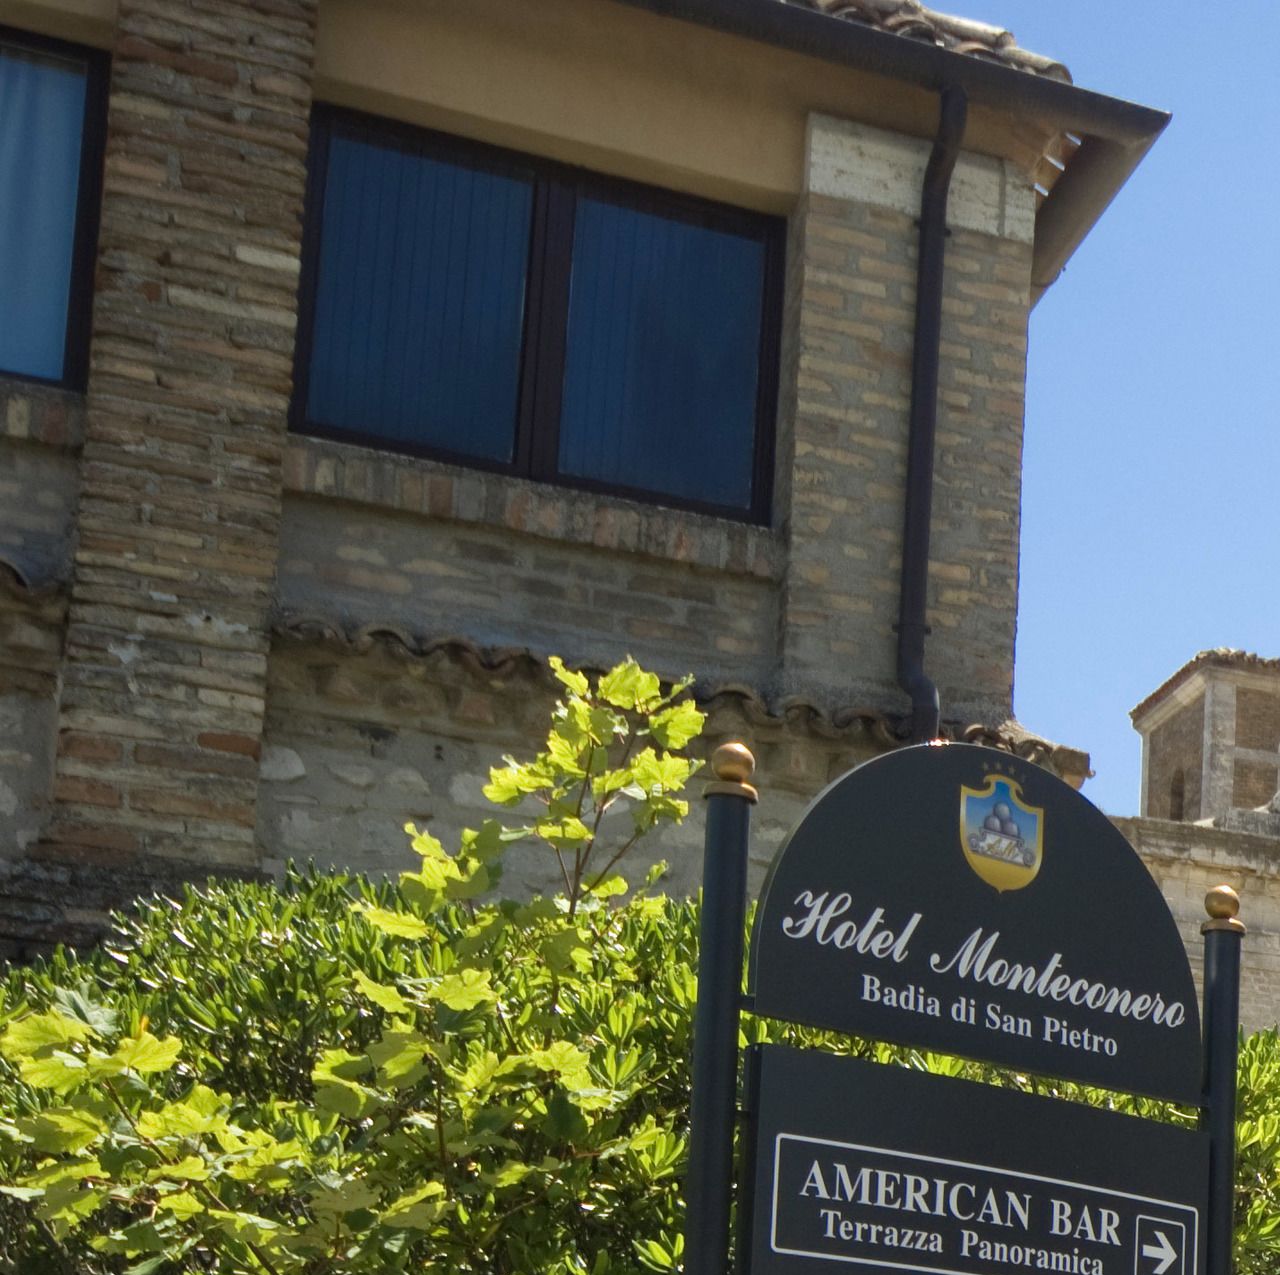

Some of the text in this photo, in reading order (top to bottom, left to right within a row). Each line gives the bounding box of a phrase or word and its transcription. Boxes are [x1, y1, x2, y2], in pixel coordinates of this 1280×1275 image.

[782, 890, 1186, 1029] Hotel Monteconero
[861, 973, 1118, 1056] Badia di San Pietro
[799, 1159, 1122, 1246] AMERICAN BAR
[819, 1208, 943, 1253] Terrazza
